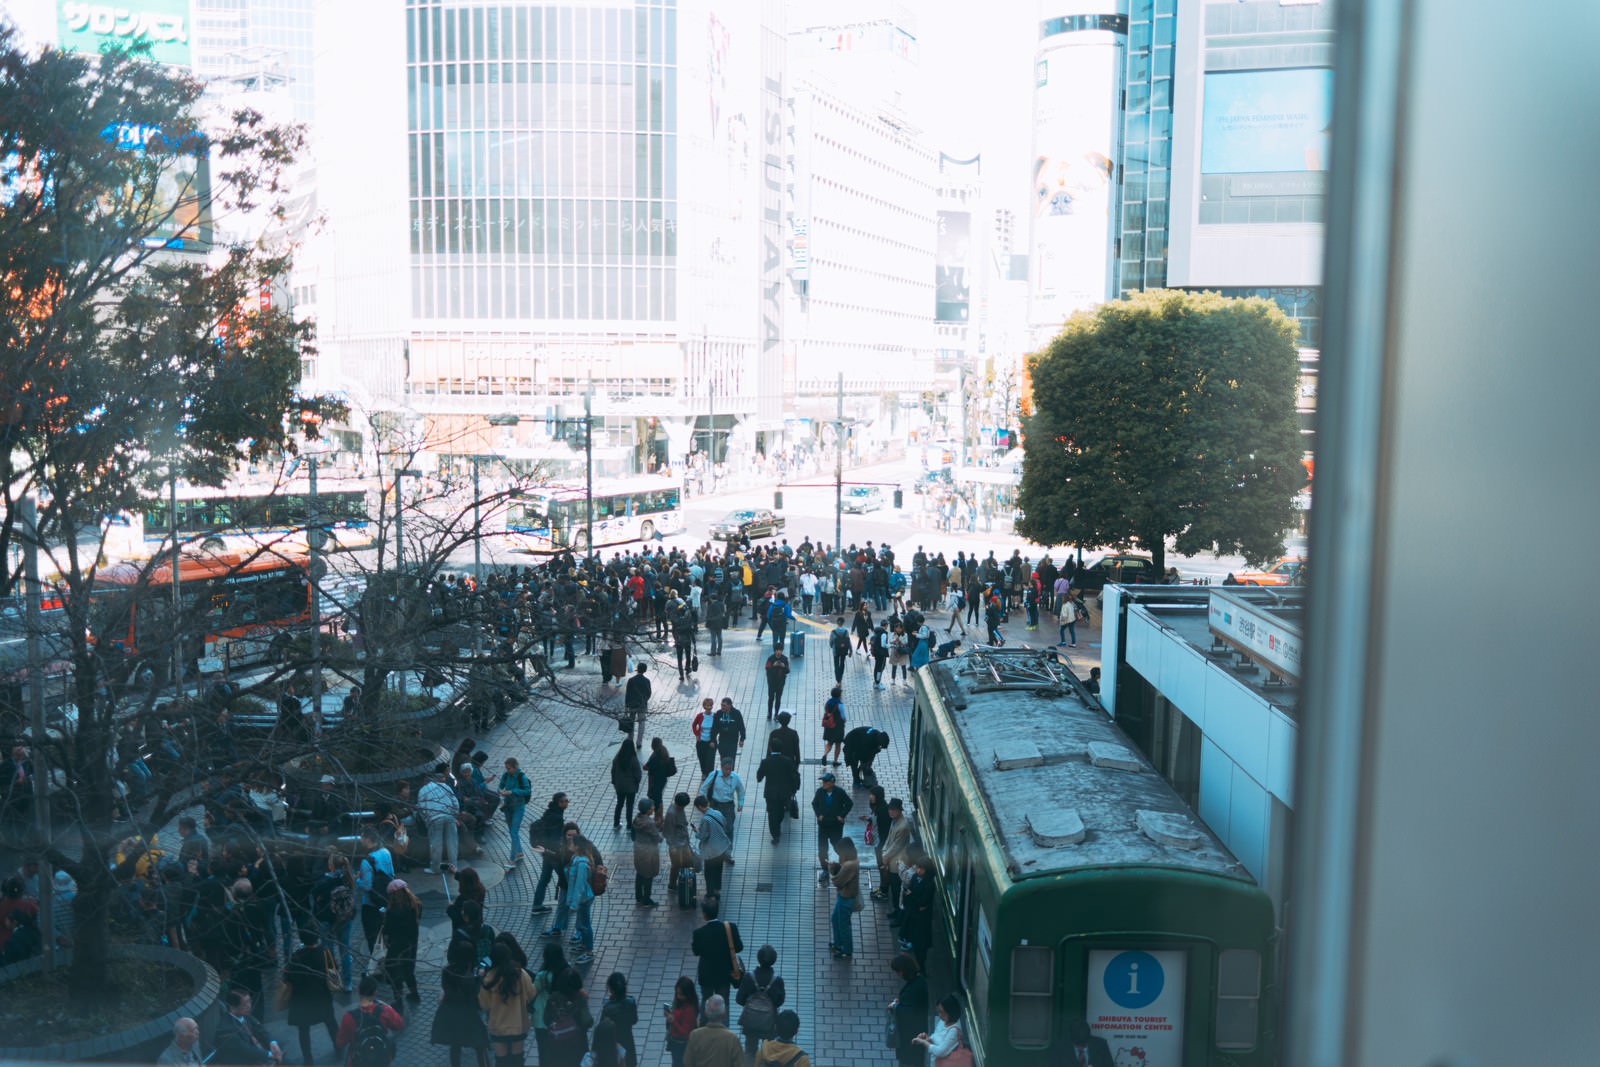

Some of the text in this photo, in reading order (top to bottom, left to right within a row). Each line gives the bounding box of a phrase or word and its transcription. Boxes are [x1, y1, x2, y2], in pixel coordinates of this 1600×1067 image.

[62, 1, 187, 43] サロンパス
[763, 71, 782, 353] TSUTAYA
